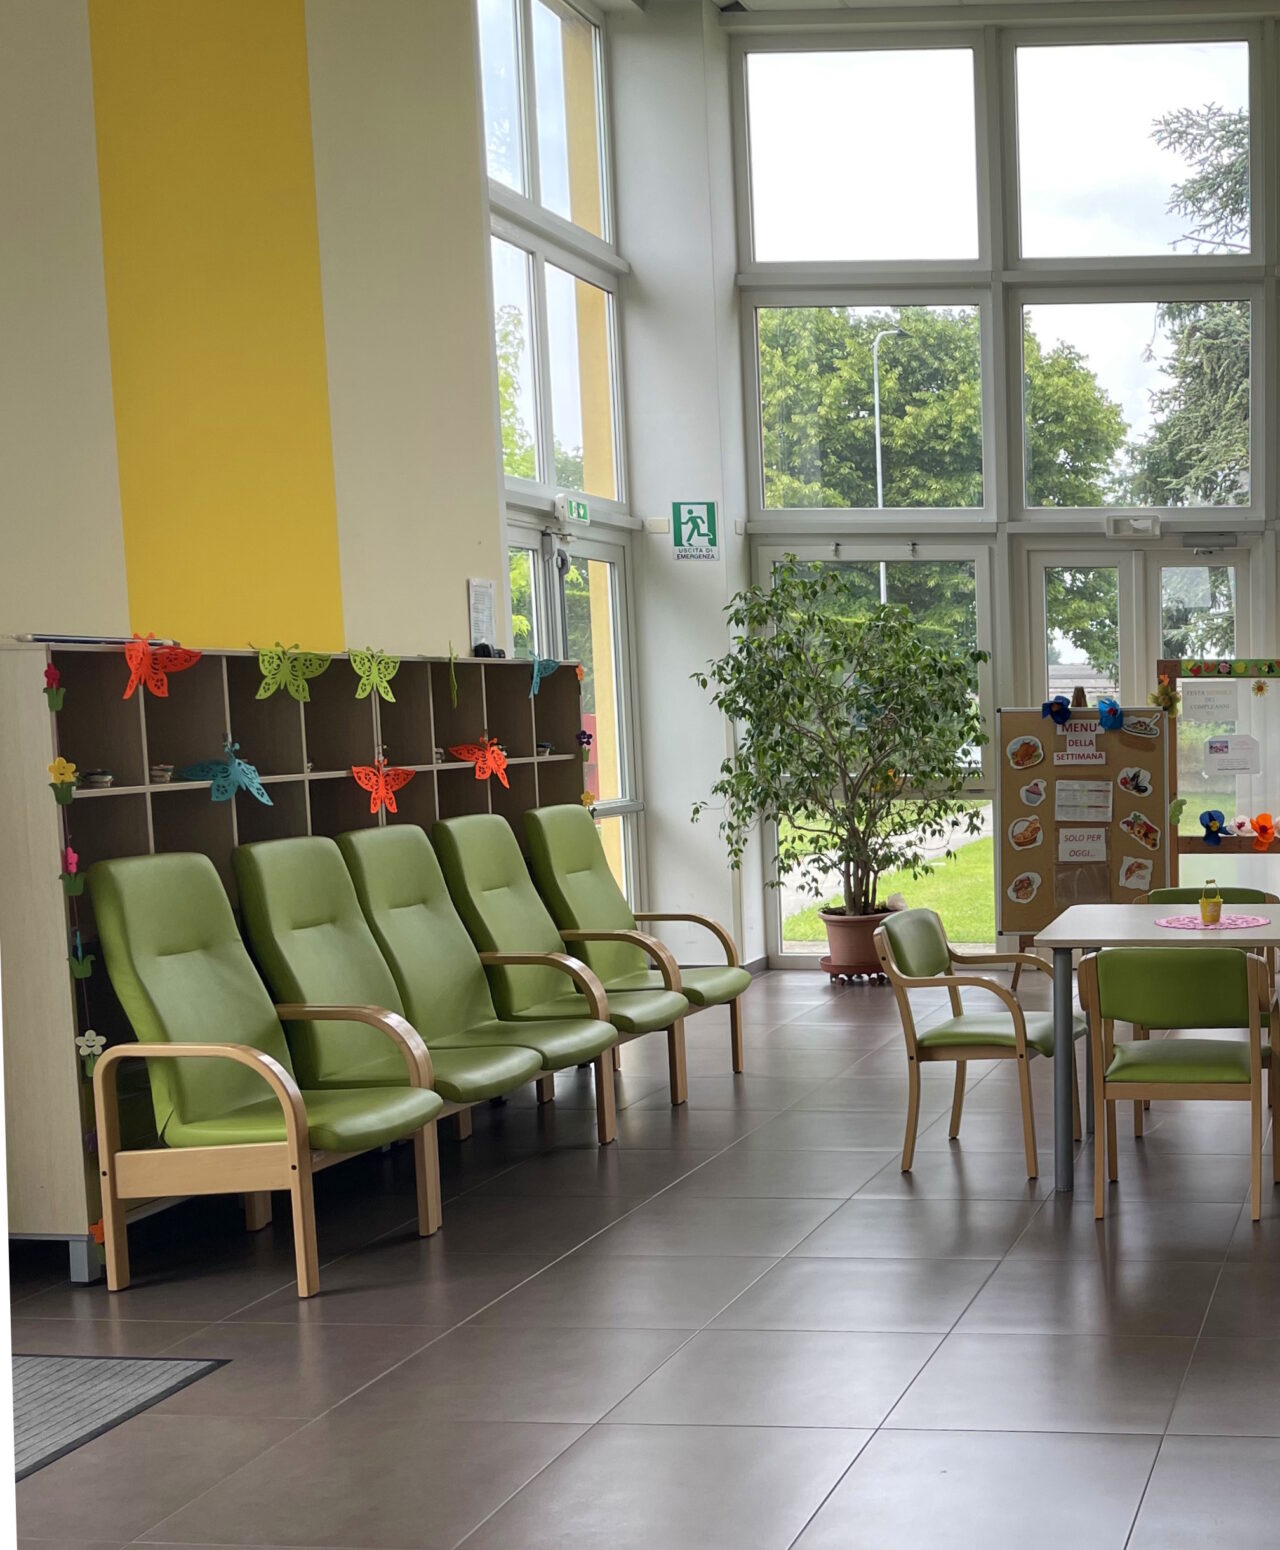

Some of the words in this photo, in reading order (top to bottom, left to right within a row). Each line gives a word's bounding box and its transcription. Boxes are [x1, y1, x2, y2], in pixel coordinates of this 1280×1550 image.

[1068, 739, 1094, 747] DELLA
[1056, 752, 1104, 761] SETTIMANA
[1064, 834, 1085, 842] SOLO
[1087, 834, 1102, 842] PER
